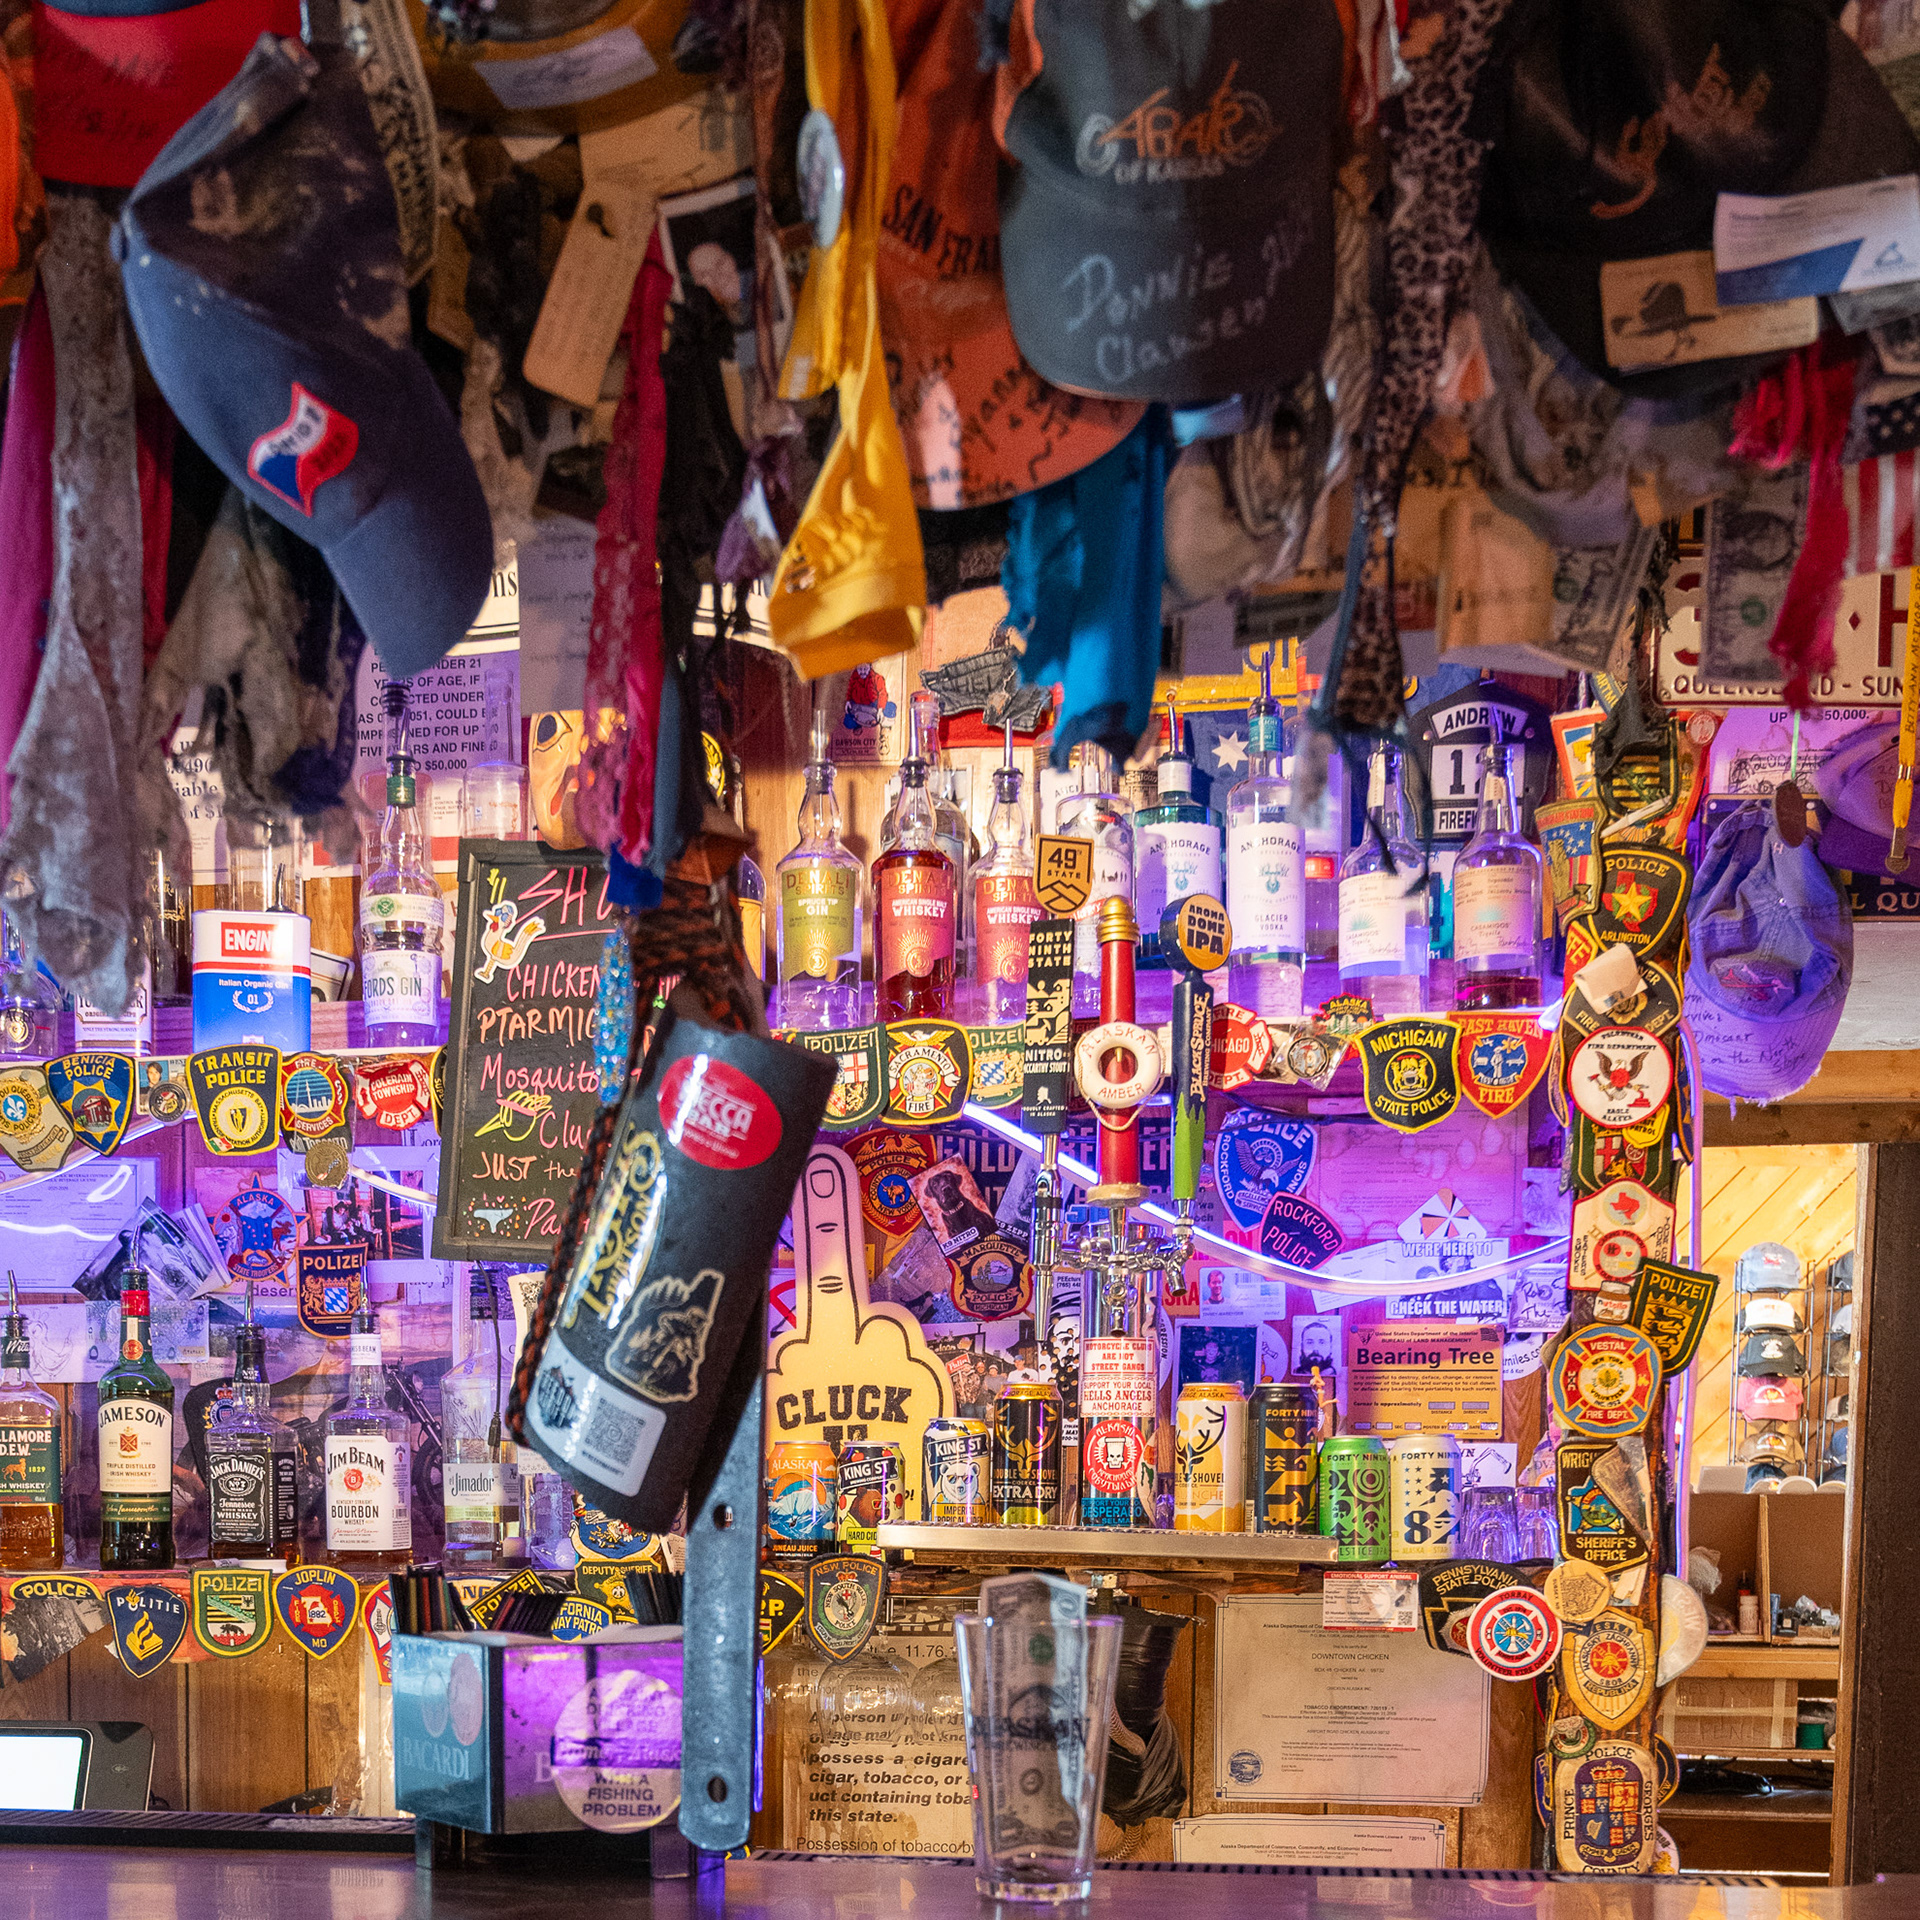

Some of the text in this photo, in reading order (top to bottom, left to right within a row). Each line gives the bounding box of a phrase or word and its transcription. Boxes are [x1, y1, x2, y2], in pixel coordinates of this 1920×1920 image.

[442, 691, 484, 703] UNDER
[357, 708, 477, 724] AS COULD
[1769, 712, 1788, 723] UP
[434, 725, 479, 738] FOR UP
[425, 759, 468, 772] $50,000
[1048, 847, 1077, 870] 49
[1604, 856, 1671, 878] POLICE
[786, 869, 849, 889] DENALI
[1048, 871, 1081, 880] STATE
[798, 898, 838, 907] SPRUCE TIP
[807, 905, 829, 916] GIN
[892, 906, 946, 919] WHISKEY
[987, 914, 1040, 926] WHISKEY
[1188, 904, 1225, 921] AROMA
[1254, 914, 1289, 923] GLACIER
[1187, 917, 1225, 935] DOME
[1029, 931, 1072, 943] FORTY
[1186, 934, 1223, 955] IPA
[1600, 929, 1650, 945] ARLINGTON
[1029, 944, 1072, 955] NINTH
[1028, 957, 1071, 968] STATE
[219, 978, 242, 987] Italian
[243, 979, 273, 989] Organic
[364, 977, 422, 999] FORDS GIN
[247, 994, 259, 1006] 01
[1330, 1000, 1368, 1010] ALASKA
[1458, 1018, 1543, 1039] EAST HAVEN
[808, 1033, 874, 1052] POLIZEI
[1082, 1025, 1158, 1058] ALASKAN
[1370, 1030, 1447, 1056] MICHIGAN
[62, 1055, 115, 1070] BENICIA
[194, 1051, 274, 1074] TRANSIT
[295, 1058, 317, 1069] FIRE
[890, 1049, 952, 1074] SACRAMENTO
[1026, 1050, 1061, 1061] NITRO
[65, 1065, 115, 1081] POLICE
[205, 1069, 267, 1090] POLICE
[372, 1084, 416, 1101] TOWNSHIP
[1099, 1083, 1145, 1100] AMBER
[1478, 1087, 1514, 1104] FIRE
[908, 1101, 932, 1113] FIRE
[1374, 1089, 1452, 1116] STATE POLICE
[296, 1117, 334, 1136] SERVICES
[1219, 1135, 1236, 1201] ROCKFORD
[236, 1193, 274, 1208] ALASKA
[1273, 1200, 1338, 1252] ROCKFORD
[1263, 1225, 1317, 1269] POLICE
[1402, 1242, 1494, 1258] WE'RE HERE TO
[303, 1253, 364, 1271] POLIZEI
[1649, 1273, 1706, 1300] POLIZEI
[972, 1291, 1013, 1302] POLICE
[1390, 1301, 1503, 1316] CHECK THE WATER
[1590, 1342, 1626, 1351] VESTAL
[1357, 1348, 1494, 1368] Bearing Tree
[1092, 1363, 1145, 1371] STREET GANGS
[1084, 1390, 1151, 1401] HELLS ANGELS
[776, 1385, 912, 1430] CLUCK
[1092, 1402, 1142, 1411] ANCHORAGE
[1266, 1408, 1299, 1417] FORTY
[99, 1406, 166, 1428] JAMESON
[935, 1437, 982, 1457] KING ST
[210, 1458, 266, 1480] JACK DANIEL'S
[327, 1446, 385, 1476] JIM BEAM
[771, 1459, 823, 1475] ALASKAN
[844, 1460, 889, 1481] KING ST
[992, 1487, 1057, 1499] EXTRA DRY
[217, 1512, 258, 1520] WHISKEY
[331, 1505, 379, 1518] BOURBON
[1576, 1537, 1637, 1549] SHERIFF'S
[1585, 1549, 1627, 1561] OFFICE
[295, 1569, 337, 1586] JOPLIN
[1364, 1573, 1388, 1581] SUPPORT
[1432, 1565, 1518, 1588] PENNSYLVANIA
[21, 1583, 88, 1599] POLICE
[200, 1576, 262, 1594] POLIZEI
[1499, 1590, 1533, 1601] TORBAY
[115, 1594, 182, 1614] POLITIE
[308, 1609, 327, 1619] 1882
[312, 1638, 327, 1648] MO
[808, 1753, 884, 1766] possess
[893, 1755, 904, 1766] a
[1584, 1747, 1636, 1761] POLICE
[809, 1771, 962, 1787] cigar, tobacco, or
[588, 1787, 654, 1802] FISHING
[809, 1790, 838, 1803] uct
[841, 1791, 931, 1806] containing
[582, 1803, 662, 1817] PROBLEM
[809, 1808, 898, 1823] this state.
[1563, 1788, 1575, 1841] PRINCE
[1643, 1780, 1654, 1842] GEORGES
